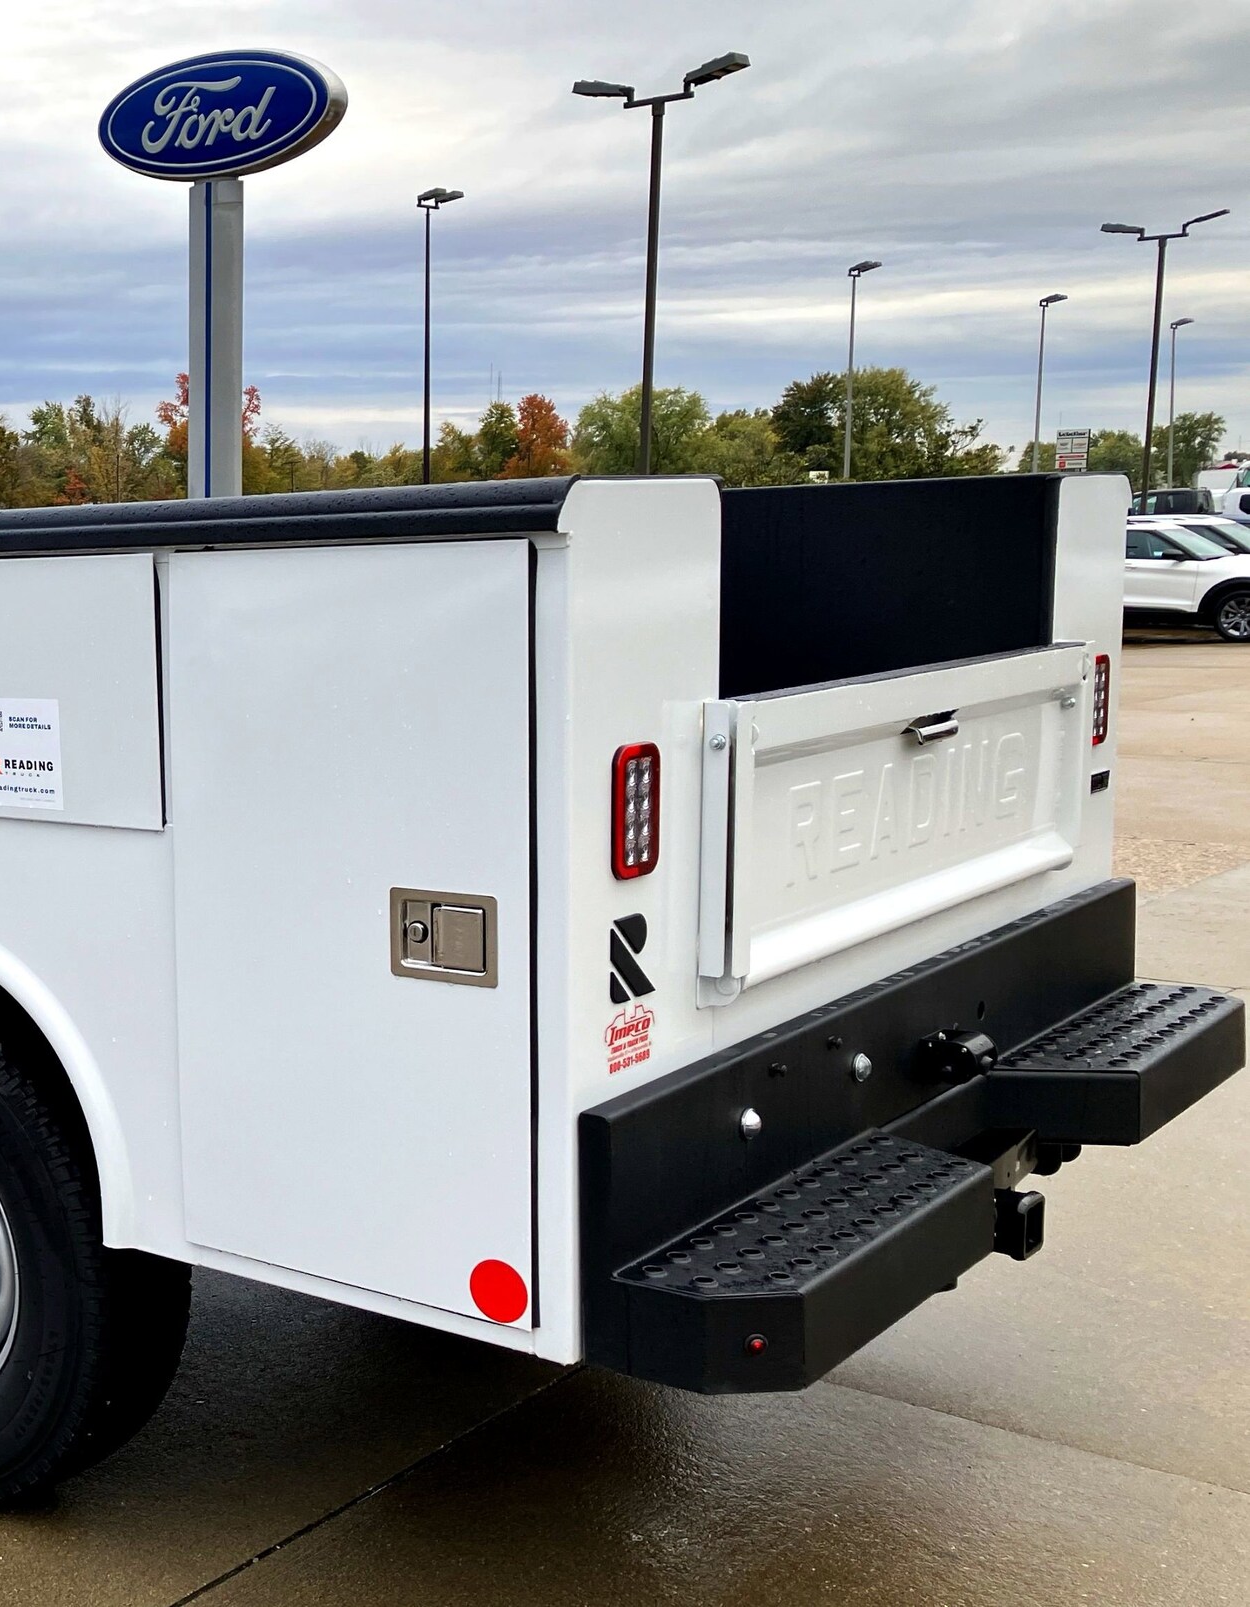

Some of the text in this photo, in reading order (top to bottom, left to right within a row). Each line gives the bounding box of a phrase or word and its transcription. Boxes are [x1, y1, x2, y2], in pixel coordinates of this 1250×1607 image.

[141, 76, 277, 154] Ford
[4, 759, 53, 771] READING
[785, 732, 1026, 889] READING
